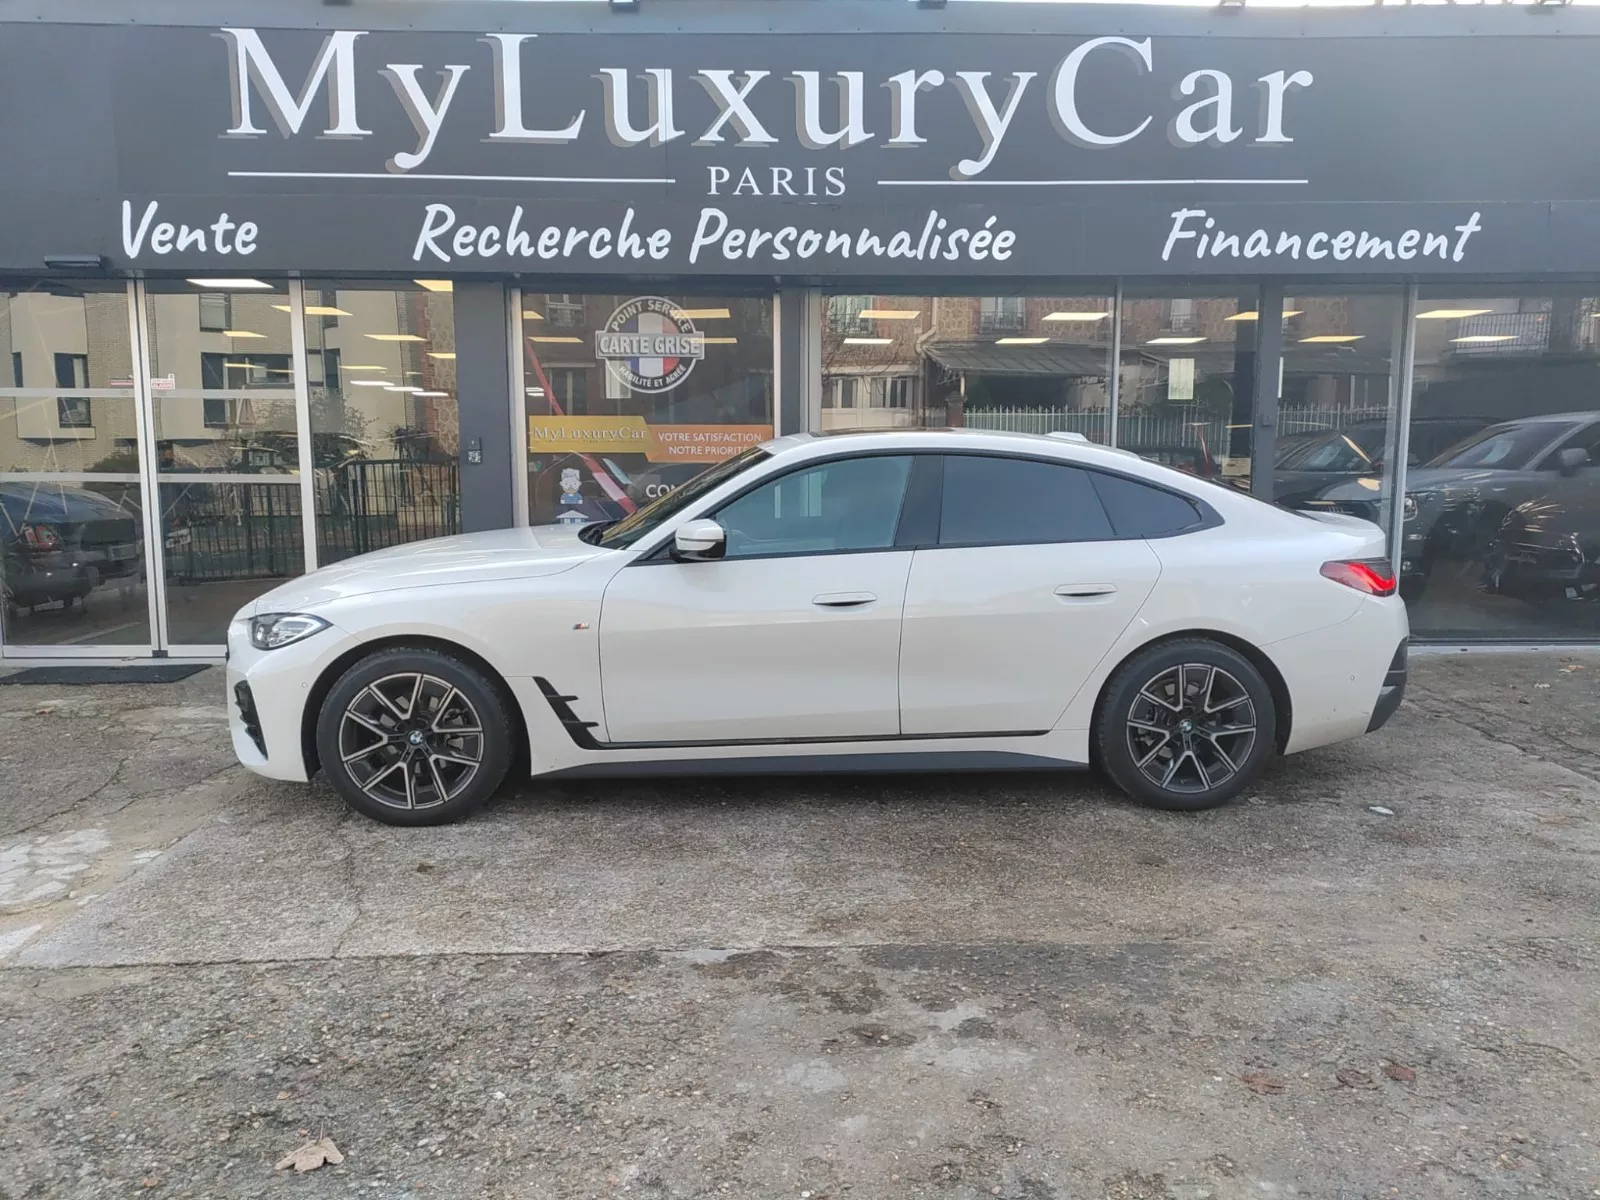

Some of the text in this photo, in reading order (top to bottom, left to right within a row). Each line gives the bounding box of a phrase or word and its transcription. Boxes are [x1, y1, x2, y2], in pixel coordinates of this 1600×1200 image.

[217, 27, 1314, 177] MyLuxuryCar
[707, 166, 846, 196] PARIS
[122, 200, 258, 259] Vente
[412, 203, 1016, 264] Recherche Personnalisée
[1161, 207, 1482, 263] Financement
[611, 301, 642, 331] POINT
[600, 335, 700, 355] CARTE GRISE
[654, 378, 664, 387] ET
[533, 425, 647, 442] MyLuxuryCar
[658, 432, 690, 442] VOTRE
[668, 445, 702, 455] NOTRE
